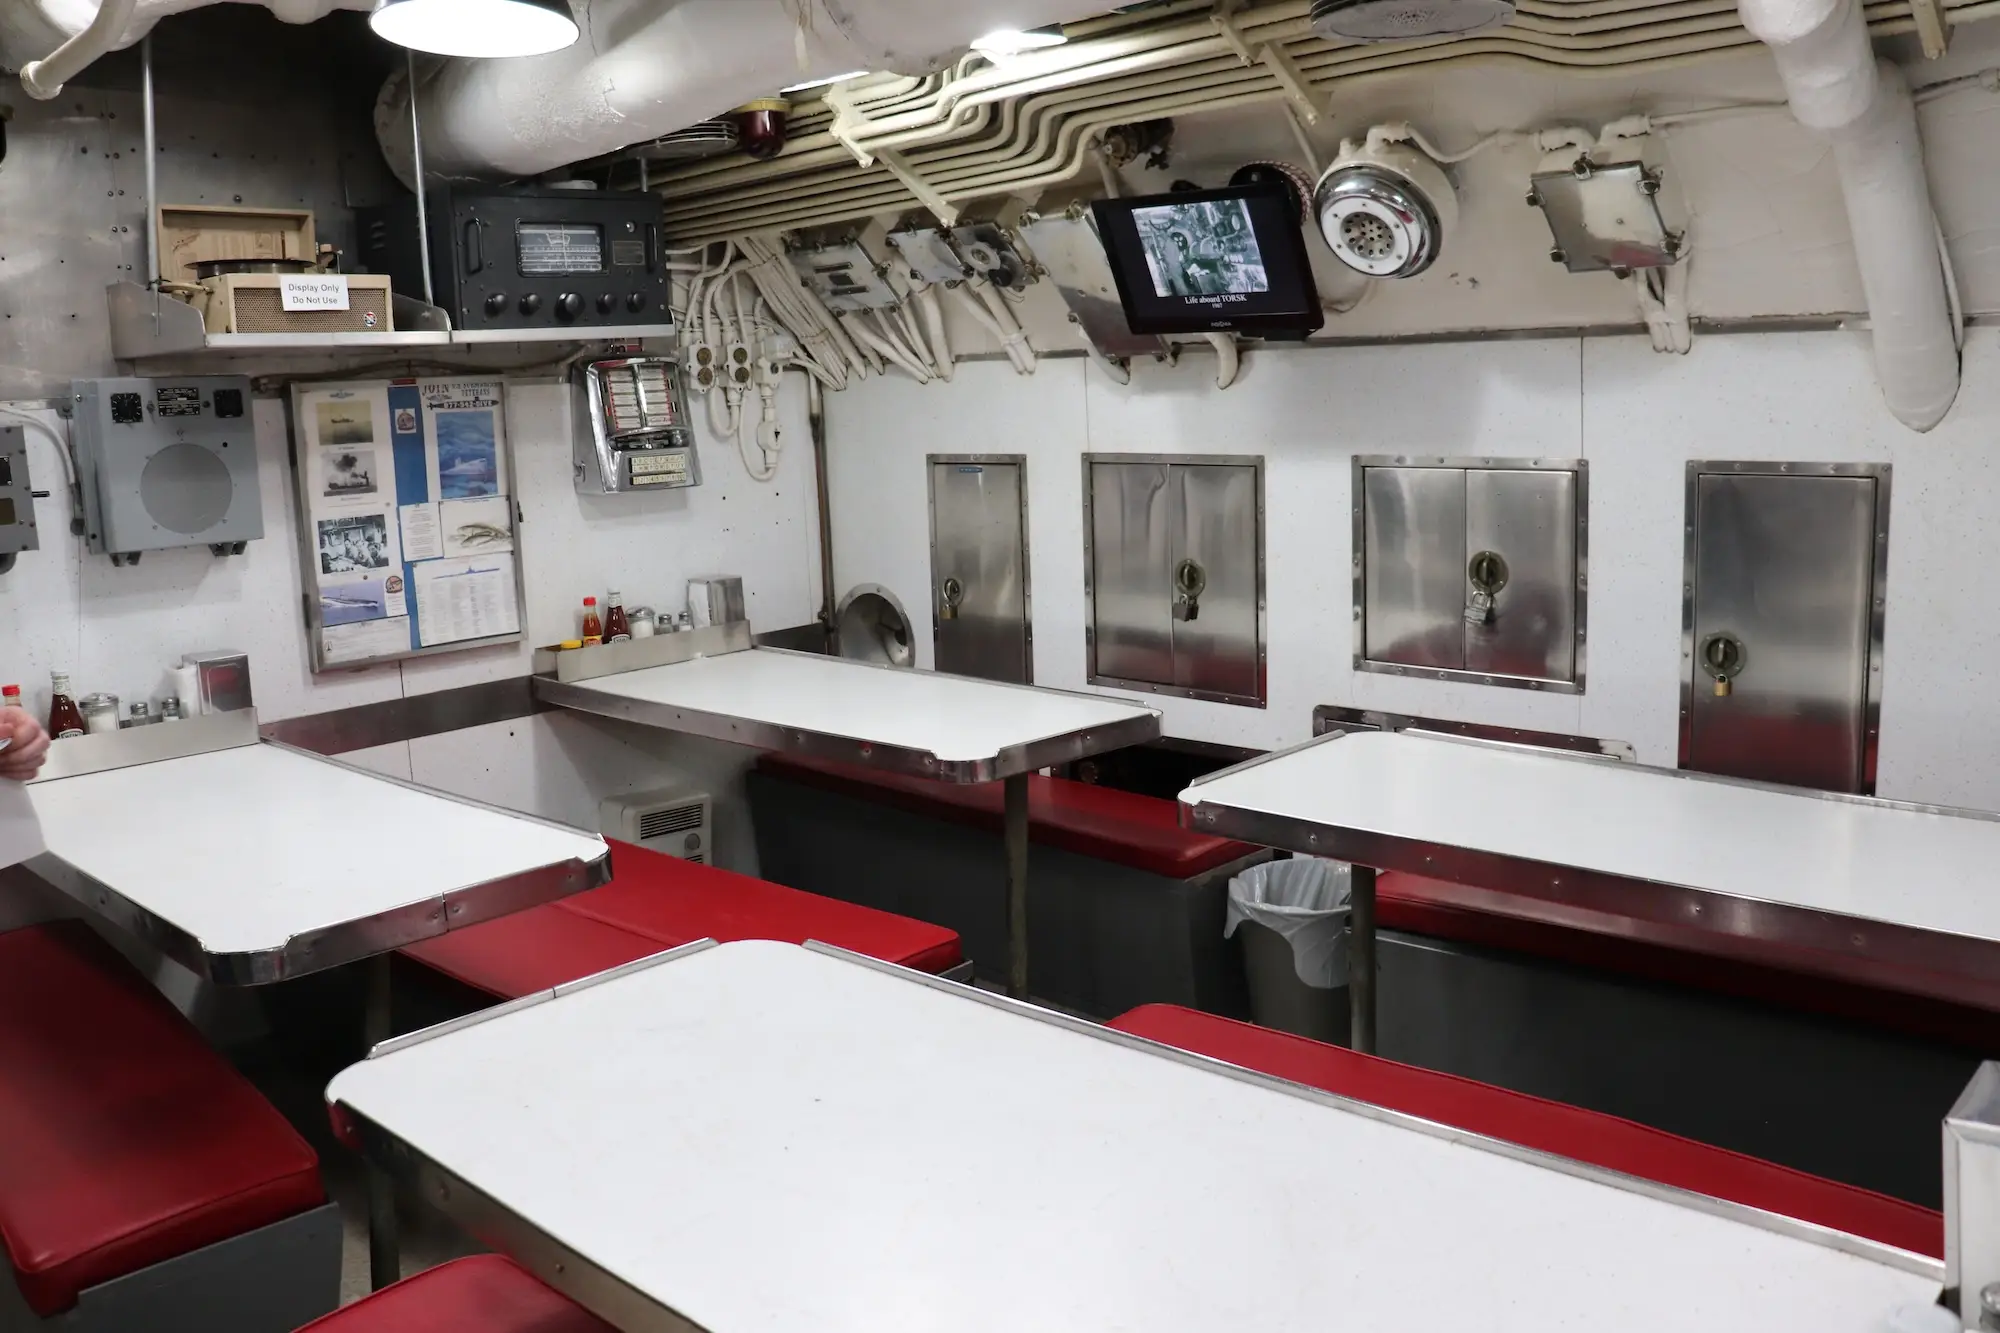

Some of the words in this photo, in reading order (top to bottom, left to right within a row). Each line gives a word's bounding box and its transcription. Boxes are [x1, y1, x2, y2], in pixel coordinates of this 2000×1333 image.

[288, 283, 319, 293] Display
[320, 283, 340, 293] Only
[292, 296, 304, 304] Do
[306, 296, 321, 304] Not
[322, 296, 338, 304] Use
[1184, 296, 1198, 304] Life
[1199, 295, 1221, 304] aboard
[1220, 294, 1247, 302] TORSK
[422, 383, 450, 396] JOIN
